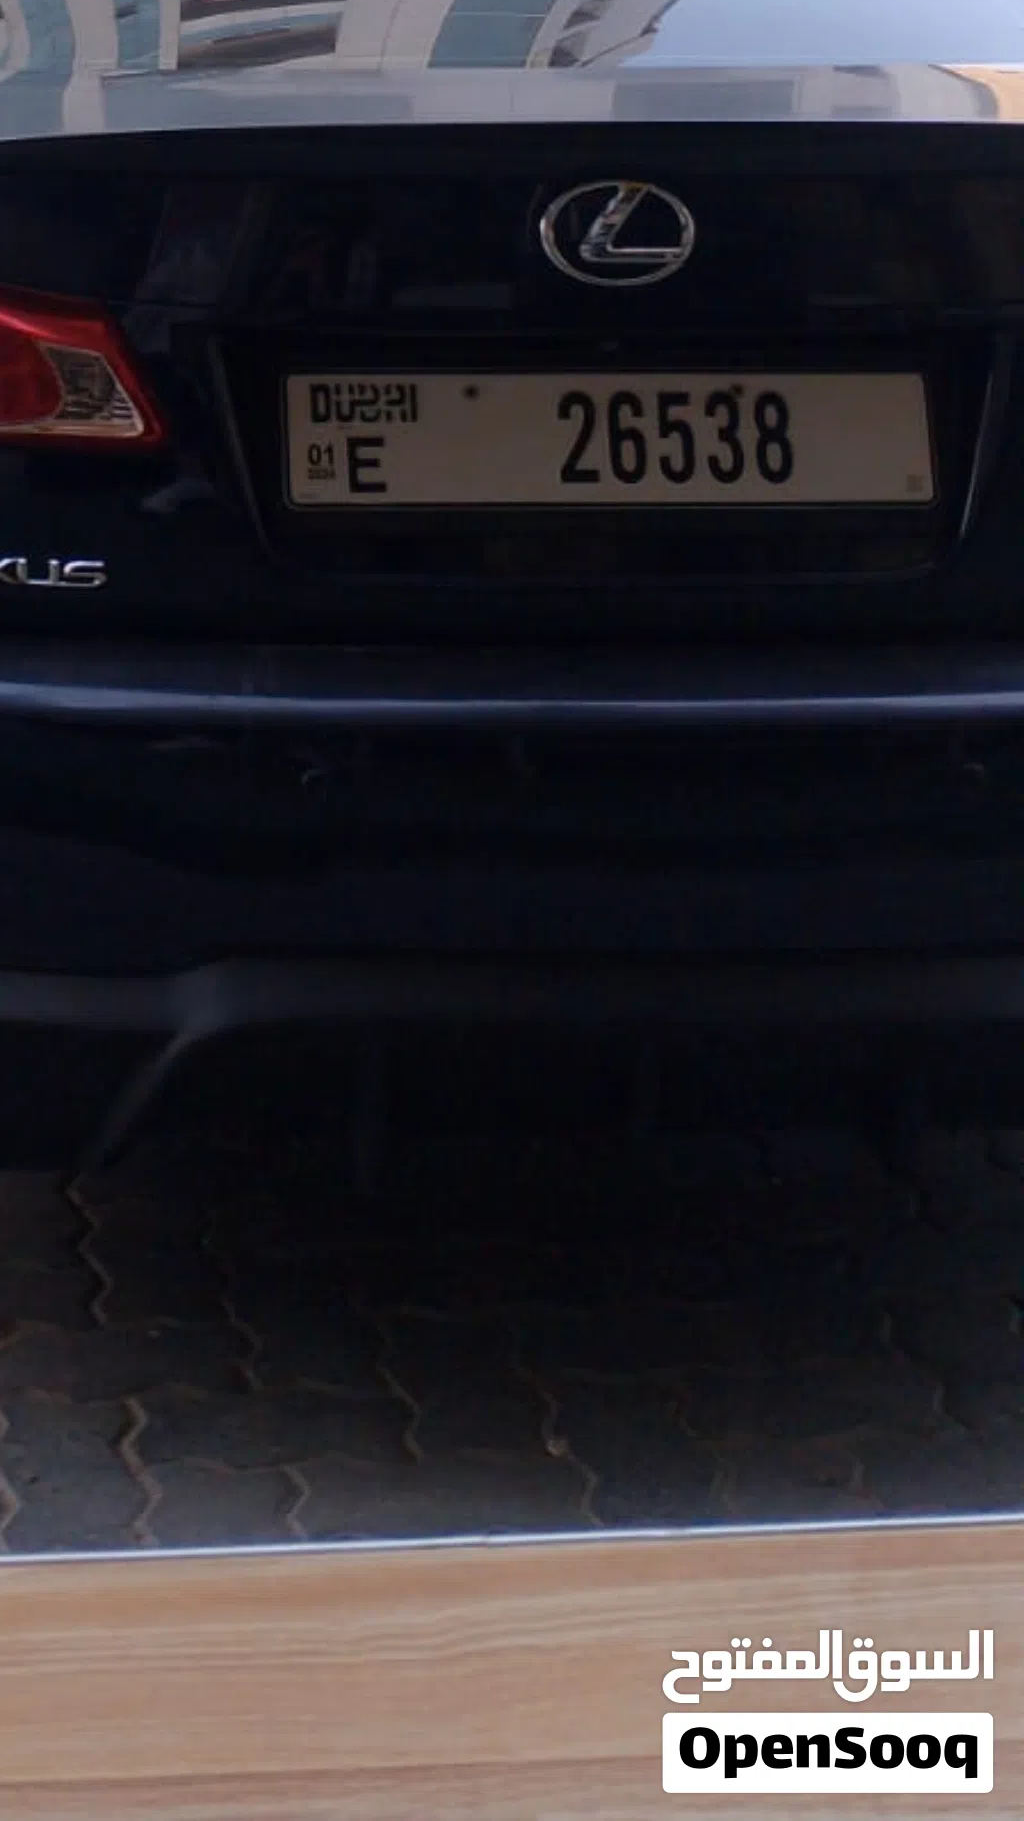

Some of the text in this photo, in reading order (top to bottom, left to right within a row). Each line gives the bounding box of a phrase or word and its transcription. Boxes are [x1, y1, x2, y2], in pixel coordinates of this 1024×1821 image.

[308, 443, 334, 465] 01
[347, 436, 387, 493] E
[557, 391, 794, 484] 26538
